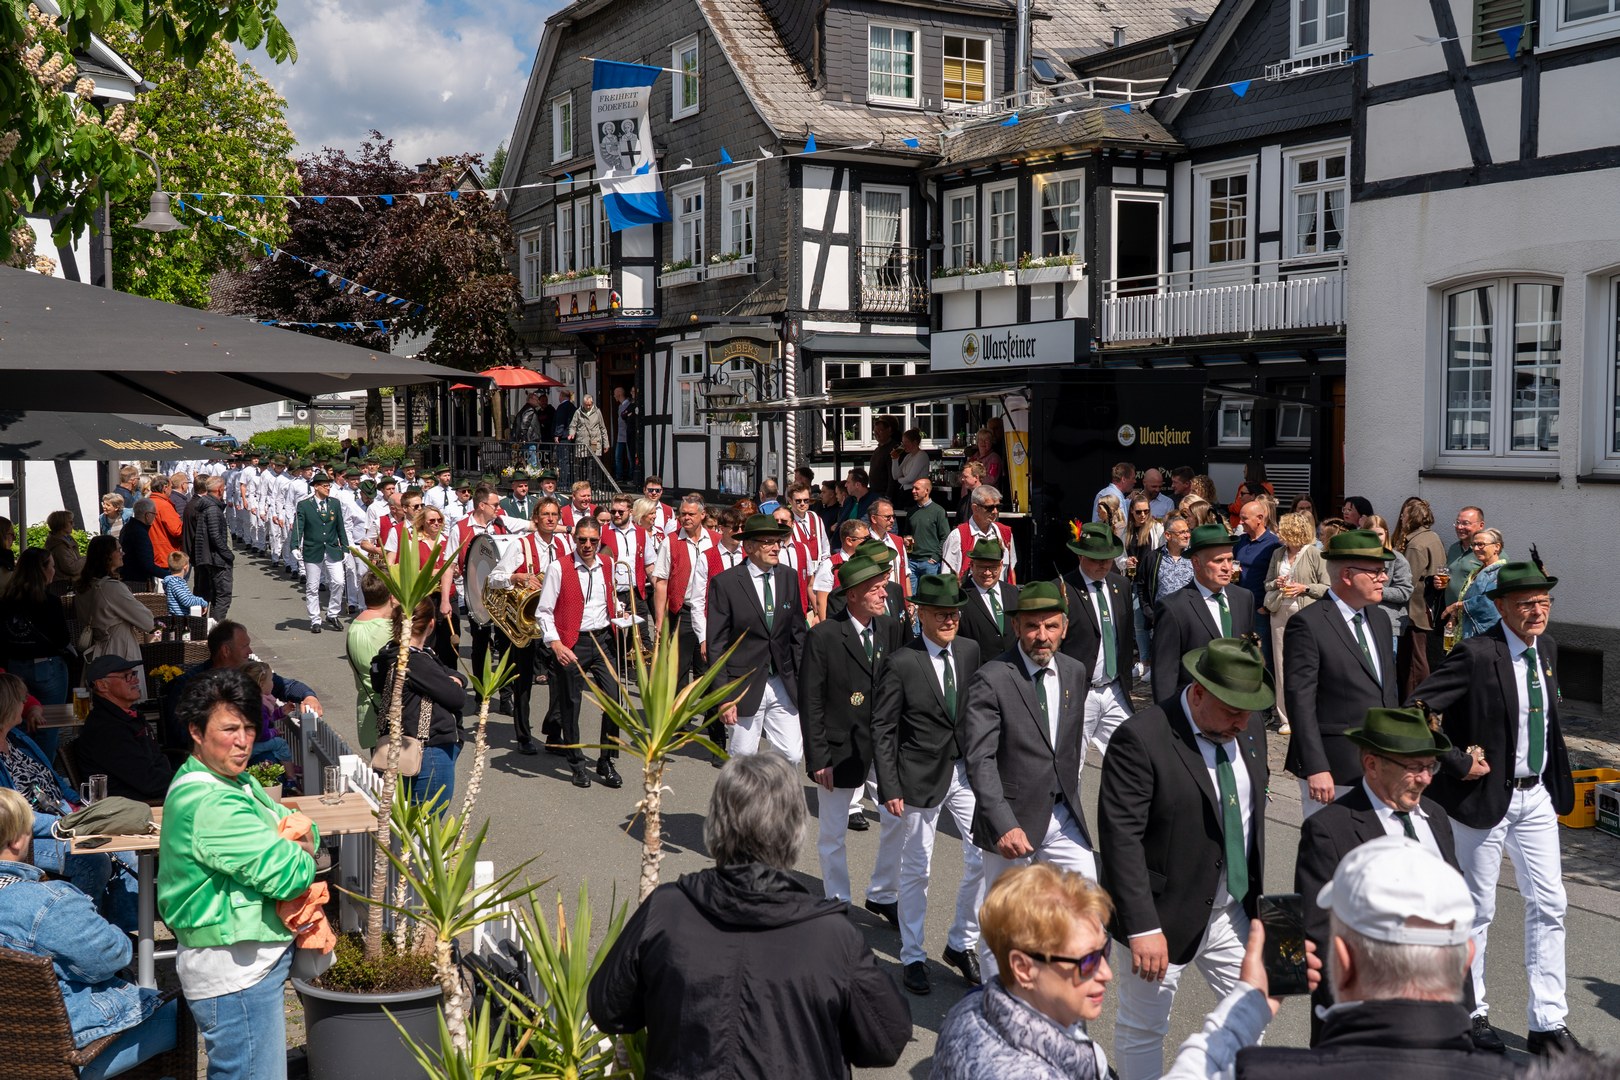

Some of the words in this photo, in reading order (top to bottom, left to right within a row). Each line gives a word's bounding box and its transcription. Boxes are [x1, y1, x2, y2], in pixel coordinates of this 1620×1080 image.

[599, 92, 639, 102] FREIHEIT
[597, 101, 639, 113] BÖDEFELD
[724, 343, 759, 357] ALBERS
[982, 330, 1036, 363] Warsteiner
[1139, 425, 1191, 446] Warsteiner
